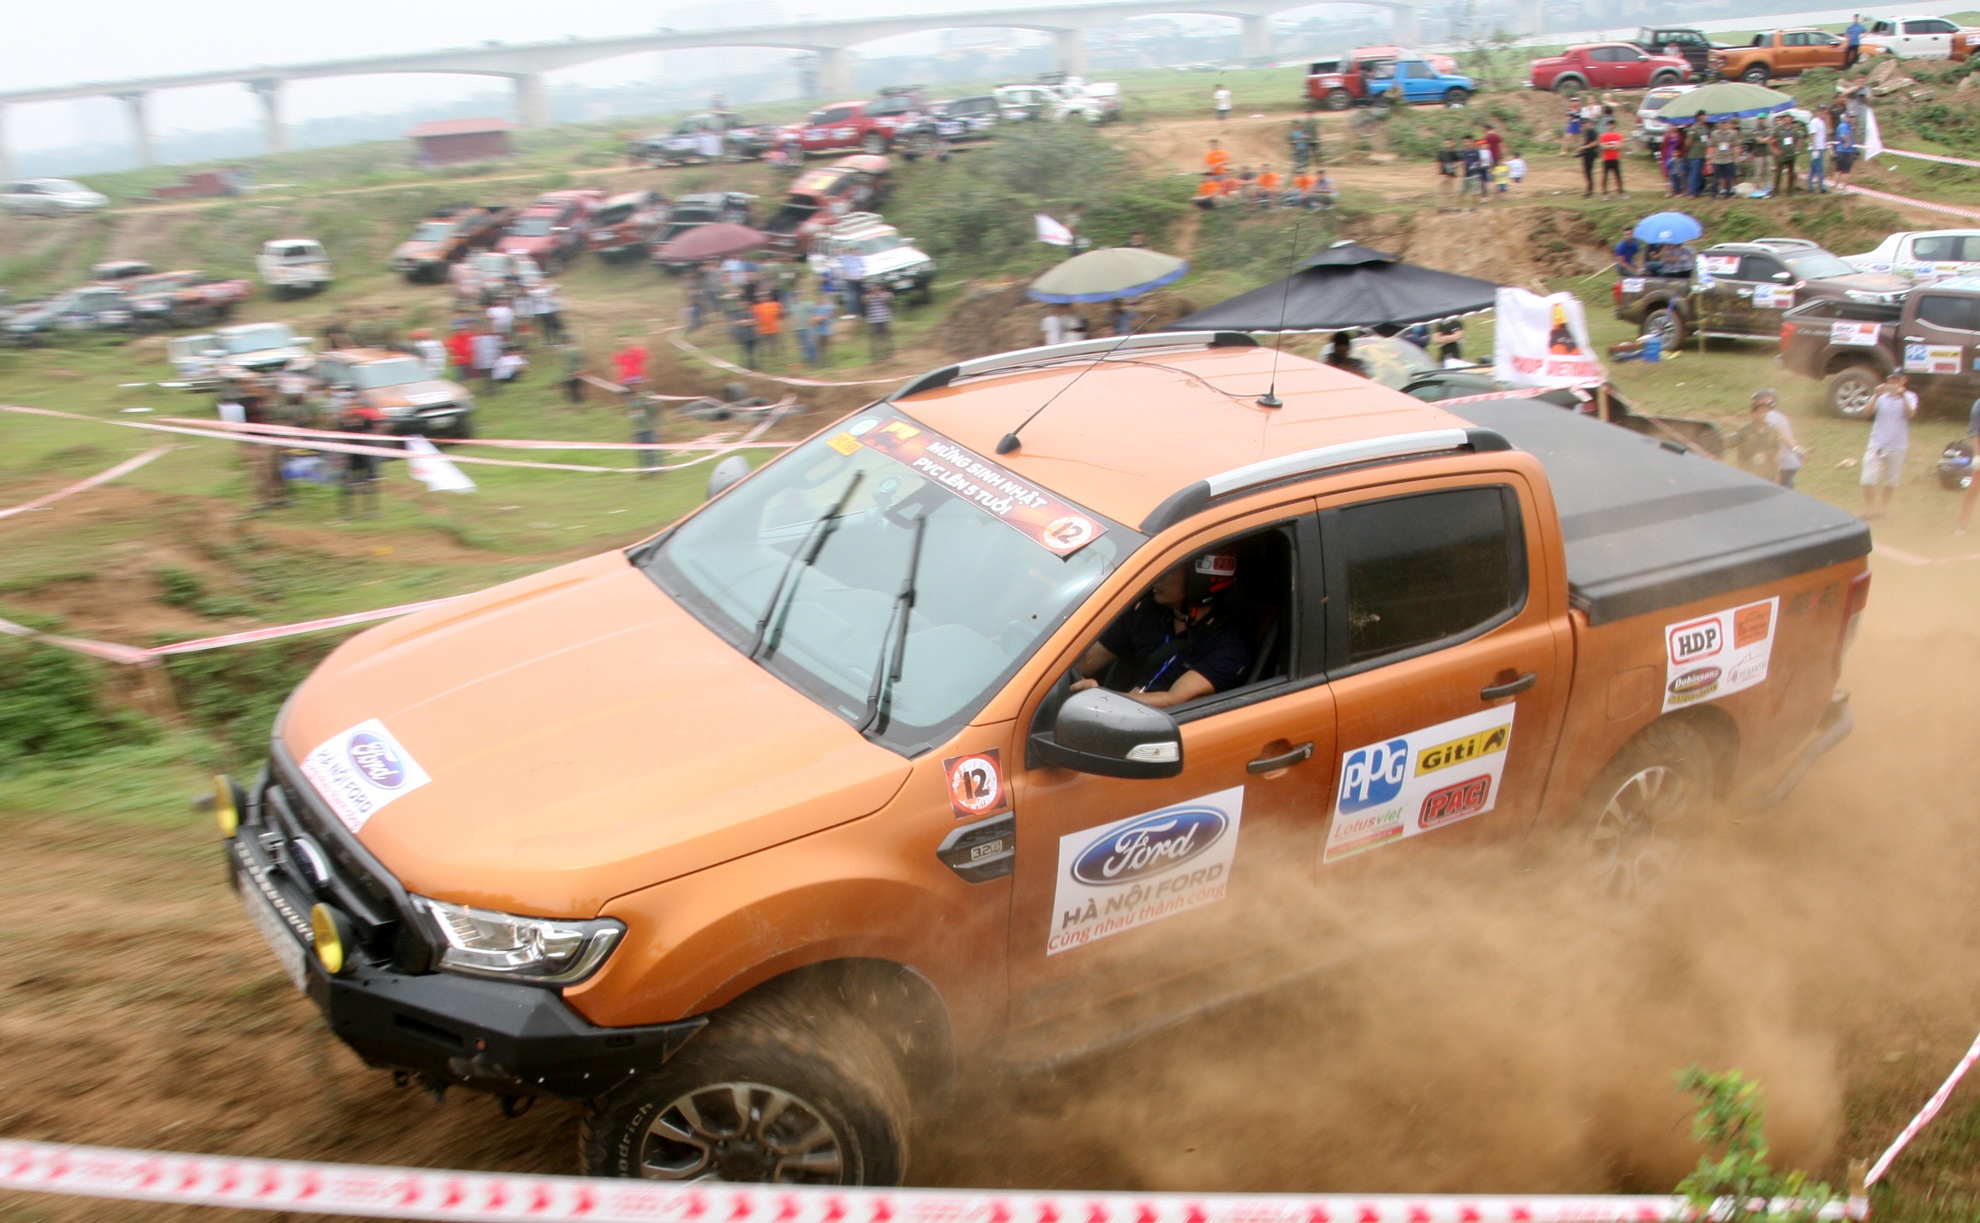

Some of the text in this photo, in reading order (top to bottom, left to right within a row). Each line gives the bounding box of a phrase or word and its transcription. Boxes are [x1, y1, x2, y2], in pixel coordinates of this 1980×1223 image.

[913, 457, 1013, 516] PVC LÊN 5 TUỔI
[926, 441, 1048, 509] MỪNG SINH NHẬT
[1051, 520, 1084, 545] 12
[1678, 628, 1717, 657] HDP
[351, 741, 401, 781] Ford
[1342, 741, 1407, 803] PPG
[1421, 739, 1476, 771] Giti
[963, 767, 990, 800] 12
[1428, 781, 1484, 819] PAC
[1102, 818, 1200, 878] Ford
[1061, 862, 1225, 930] HÀ NỘI FORD
[1048, 926, 1091, 951] Cùng
[1094, 911, 1136, 937] nhau
[1138, 895, 1185, 922] thành
